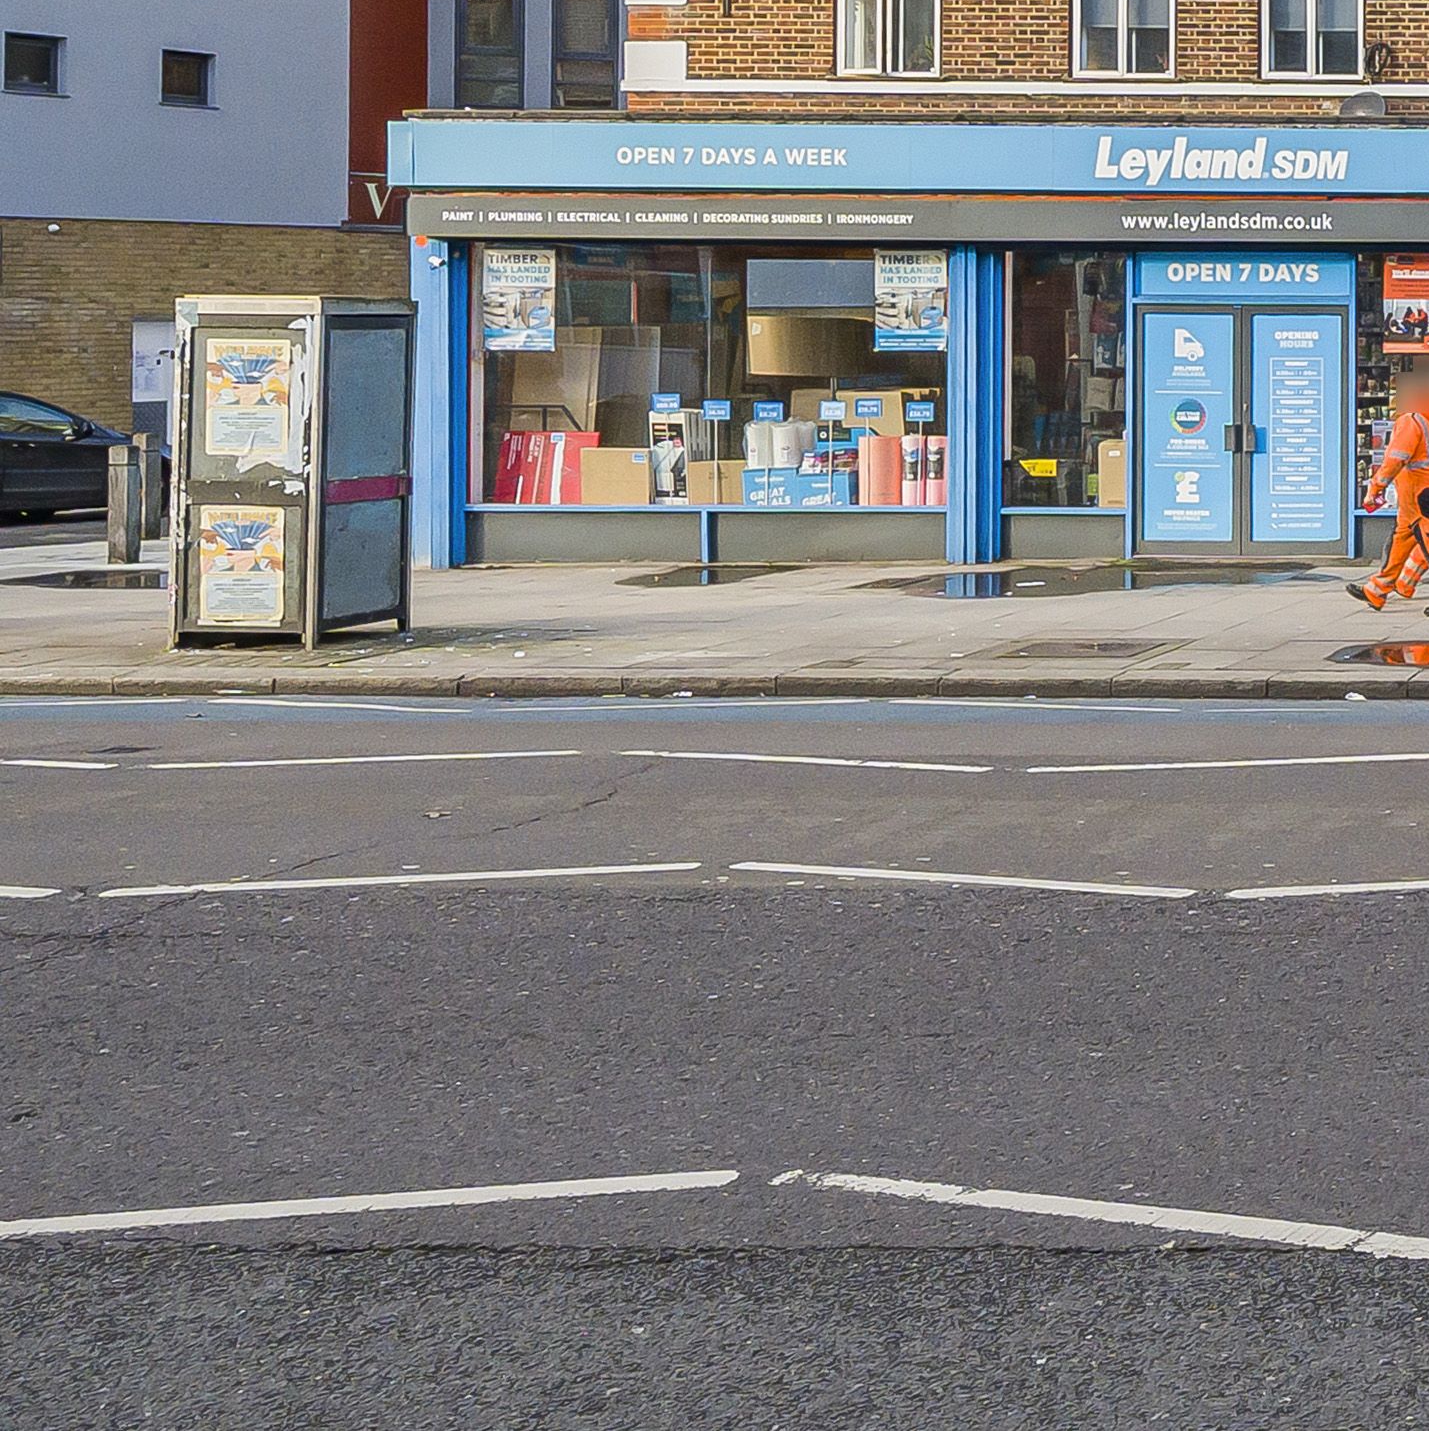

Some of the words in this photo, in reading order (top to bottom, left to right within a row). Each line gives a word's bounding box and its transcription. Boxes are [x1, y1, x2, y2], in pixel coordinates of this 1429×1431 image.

[616, 146, 675, 166] OPEN
[683, 147, 695, 166] 7
[701, 147, 757, 166] DAYS
[763, 148, 778, 166] A
[784, 148, 848, 167] WEEK
[1094, 136, 1267, 186] Leyland
[1271, 150, 1349, 180] SDM
[441, 210, 475, 222] PAINT
[487, 211, 543, 223] PLUMBING
[555, 211, 622, 224] ELECTRICAL
[634, 212, 690, 224] CLEANING
[702, 212, 769, 225] DECORATING
[770, 213, 823, 225] SUNDRIES
[836, 213, 915, 225] IRONMONGERY
[1121, 212, 1334, 232] www.leylandsdm.co.uk
[488, 254, 538, 264] TIMBER
[880, 255, 930, 265] TIMBER
[511, 266, 550, 274] LANDED
[880, 266, 901, 274] HAS
[1167, 263, 1231, 282] OPEN
[1239, 263, 1252, 282] 7
[1258, 263, 1320, 283] DAYS
[491, 275, 501, 283] IN
[505, 275, 548, 283] TOOTING
[883, 276, 893, 284] IN
[897, 276, 939, 284] TOOTING
[749, 487, 785, 501] GRAT
